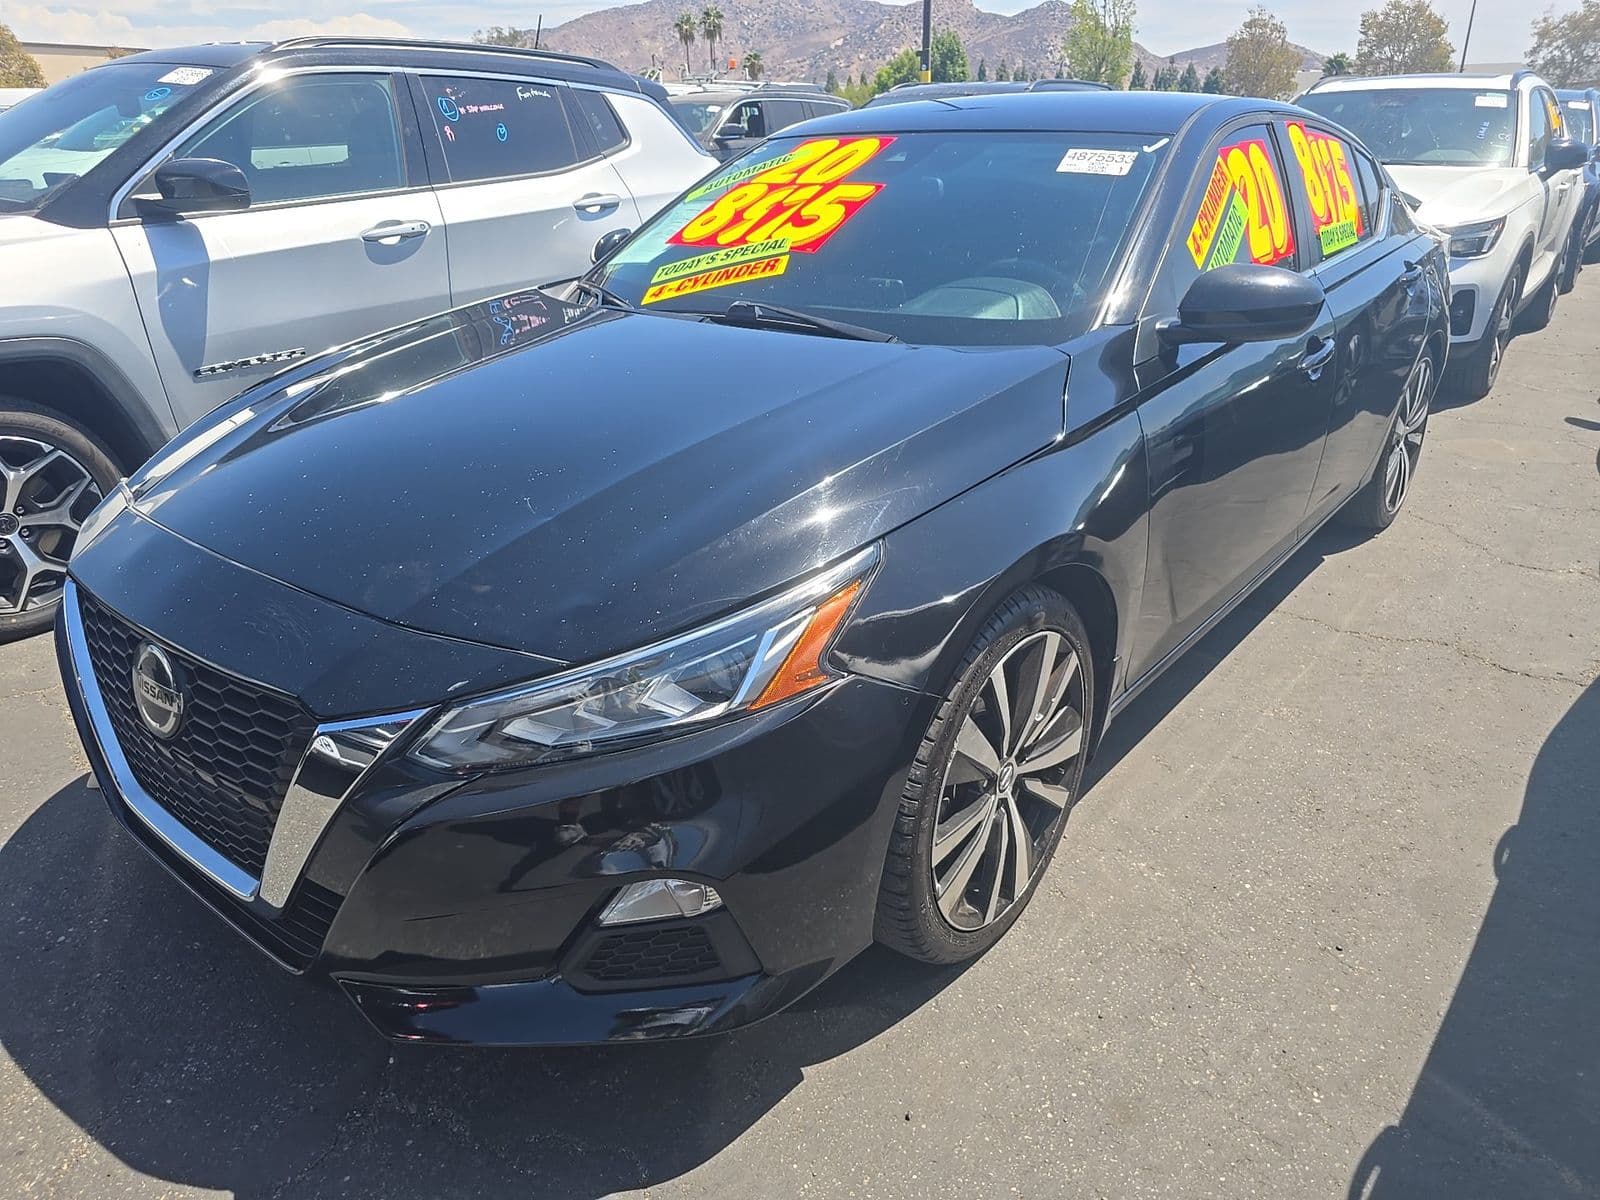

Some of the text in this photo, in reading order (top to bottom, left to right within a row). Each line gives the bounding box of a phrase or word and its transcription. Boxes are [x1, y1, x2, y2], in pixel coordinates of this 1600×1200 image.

[702, 153, 793, 194] AUTOMATIC
[750, 138, 881, 185] 20
[1191, 163, 1229, 256] 4-CYLINDER
[1227, 143, 1288, 263] 20
[649, 257, 781, 299] 4-CYLINDER
[656, 237, 788, 279] TODAY'S SPECIAL
[137, 675, 175, 708] NISSAN
